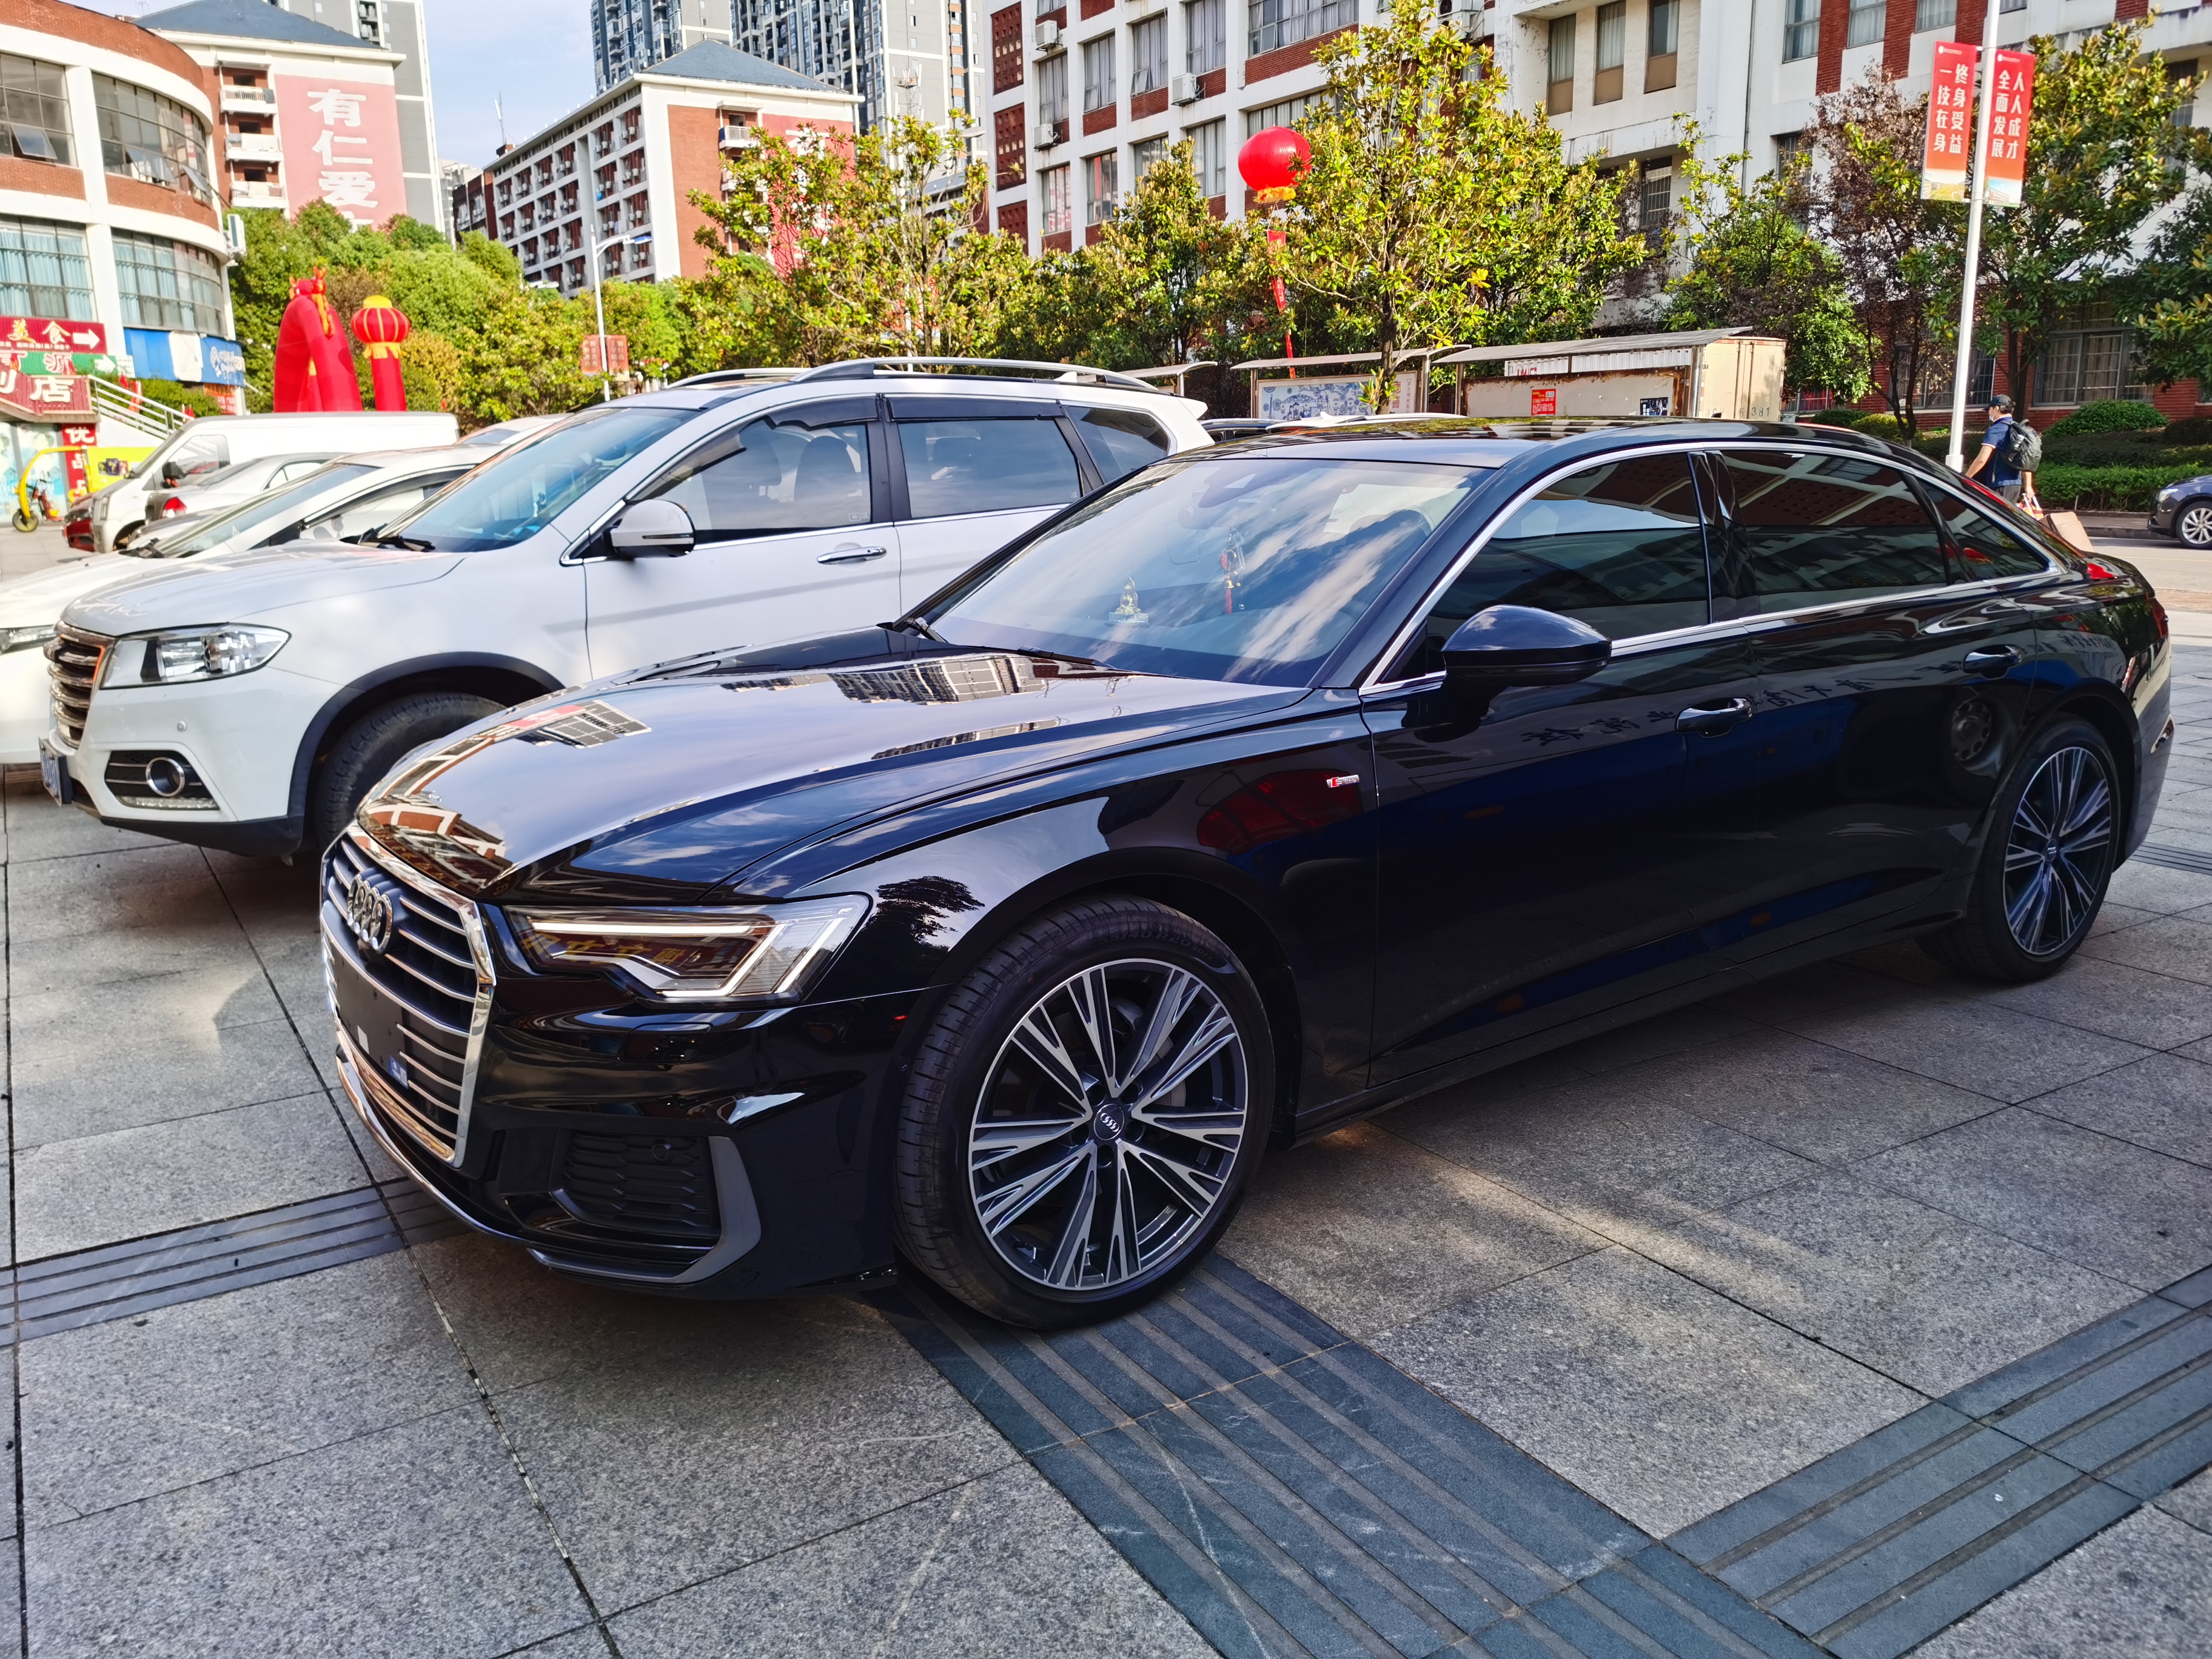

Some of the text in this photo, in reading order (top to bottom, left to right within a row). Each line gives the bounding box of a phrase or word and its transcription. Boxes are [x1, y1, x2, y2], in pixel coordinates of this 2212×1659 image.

[1933, 67, 1953, 152] 一技在身
[1948, 63, 1969, 154] 终身受益
[1991, 69, 2010, 158] 全面发展
[2006, 72, 2025, 159] 人人成才
